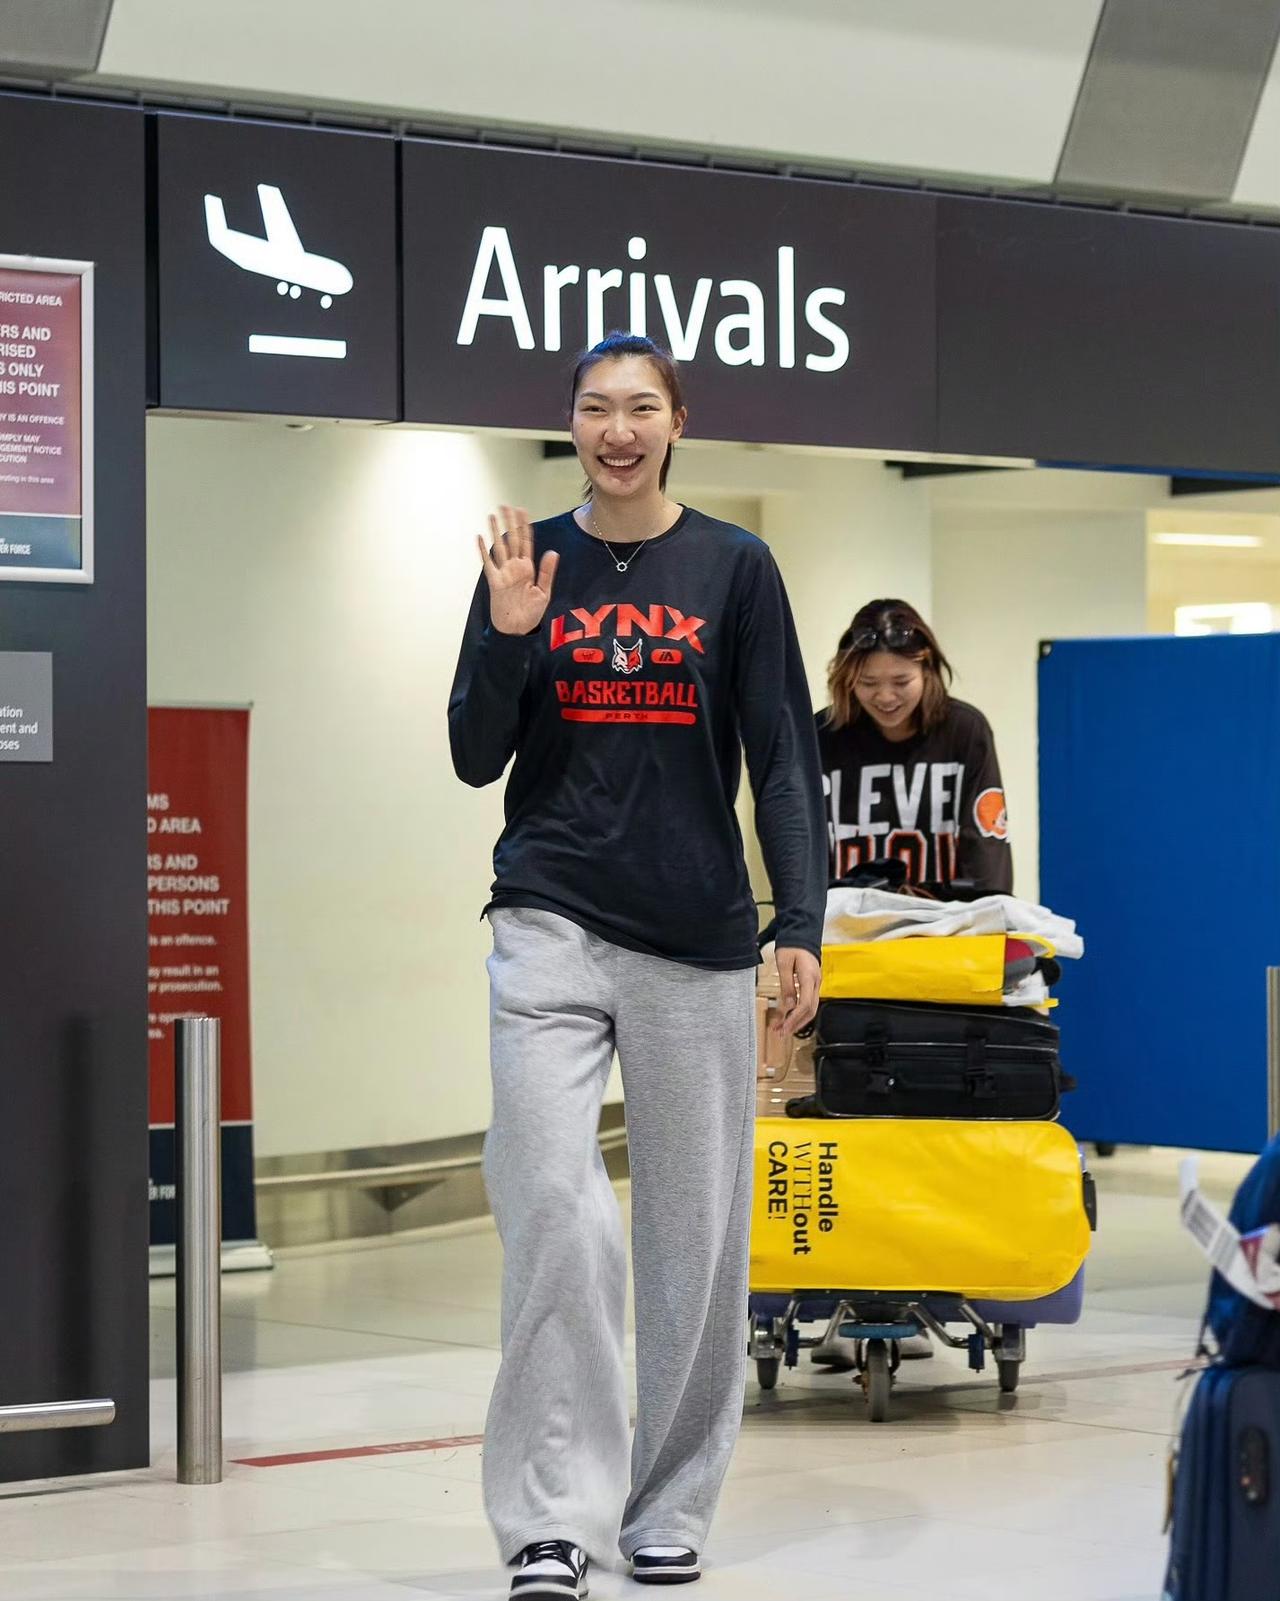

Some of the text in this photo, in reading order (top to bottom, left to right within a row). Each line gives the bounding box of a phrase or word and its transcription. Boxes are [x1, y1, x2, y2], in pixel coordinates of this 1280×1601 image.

[35, 294, 63, 306] AREA
[457, 226, 850, 372] Arrivals
[0, 324, 51, 341] RS AND
[8, 362, 44, 377] ONLY
[19, 382, 60, 397] POINT
[29, 414, 65, 425] OFFENCE
[23, 434, 40, 443] MAY
[33, 445, 62, 455] NOTICE
[551, 604, 707, 654] LYNX
[555, 681, 698, 707] BASKETBALL
[604, 712, 649, 721] PERTH
[18, 721, 39, 734] and
[159, 818, 202, 833] AREA
[165, 854, 198, 870] AND
[148, 875, 220, 892] PERSONS
[148, 899, 230, 915] THIS POINT
[768, 1141, 788, 1220] CARE!
[819, 1143, 838, 1232] Handle
[793, 1142, 812, 1256] WITHout
